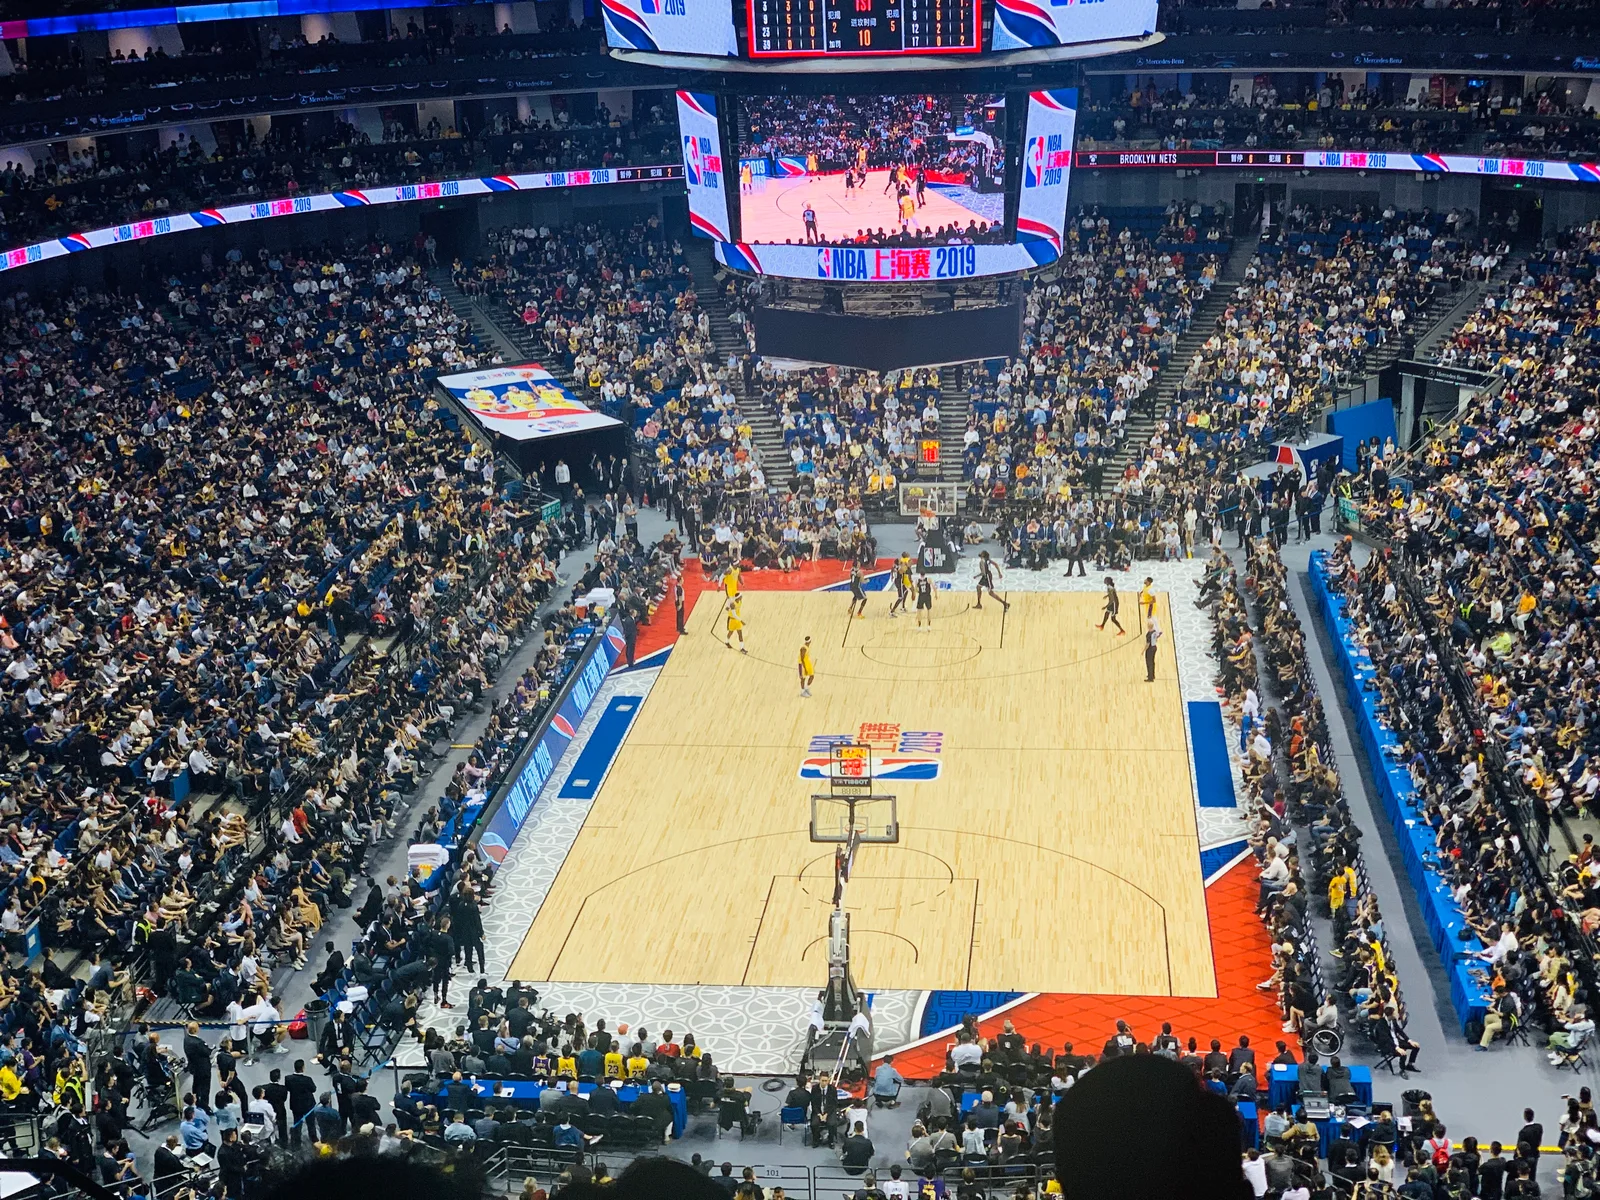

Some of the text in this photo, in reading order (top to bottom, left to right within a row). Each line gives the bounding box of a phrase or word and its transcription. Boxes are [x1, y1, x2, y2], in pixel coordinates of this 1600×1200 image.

[664, 0, 686, 15] 2019
[762, 1, 814, 11] 3 3 0
[763, 14, 814, 24] 9 5 1
[913, 10, 963, 21] 8 6 1
[762, 26, 815, 37] 23 7 0
[832, 22, 837, 33] 2
[890, 20, 895, 32] 5
[912, 23, 963, 33] 12 2 1
[763, 39, 814, 50] 39 0 1
[859, 29, 871, 46] 10
[912, 35, 964, 46] 17 0 2
[699, 137, 712, 154] NBA
[1047, 134, 1062, 152] NBA
[1120, 154, 1177, 164] BROOKLYN NETS
[1326, 153, 1340, 166] NBA
[1368, 154, 1386, 168] 2019
[667, 168, 672, 177] 2
[1484, 160, 1499, 172] NBA
[1526, 162, 1544, 176] 2019
[552, 174, 565, 186] NBA
[592, 170, 609, 183] 2019
[703, 171, 718, 188] 2019
[1044, 168, 1062, 186] 2019
[402, 186, 416, 200] NBA
[442, 182, 459, 196] 2019
[257, 203, 270, 218] NBA
[294, 198, 312, 212] 2019
[119, 226, 132, 241] NBA
[154, 218, 170, 234] 2019
[28, 245, 42, 262] 2019
[833, 245, 975, 280] NBA 上海赛 2019
[1436, 371, 1467, 381] Mercedes-Benz
[898, 732, 944, 753] 2019
[608, 1065, 619, 1074] 23
